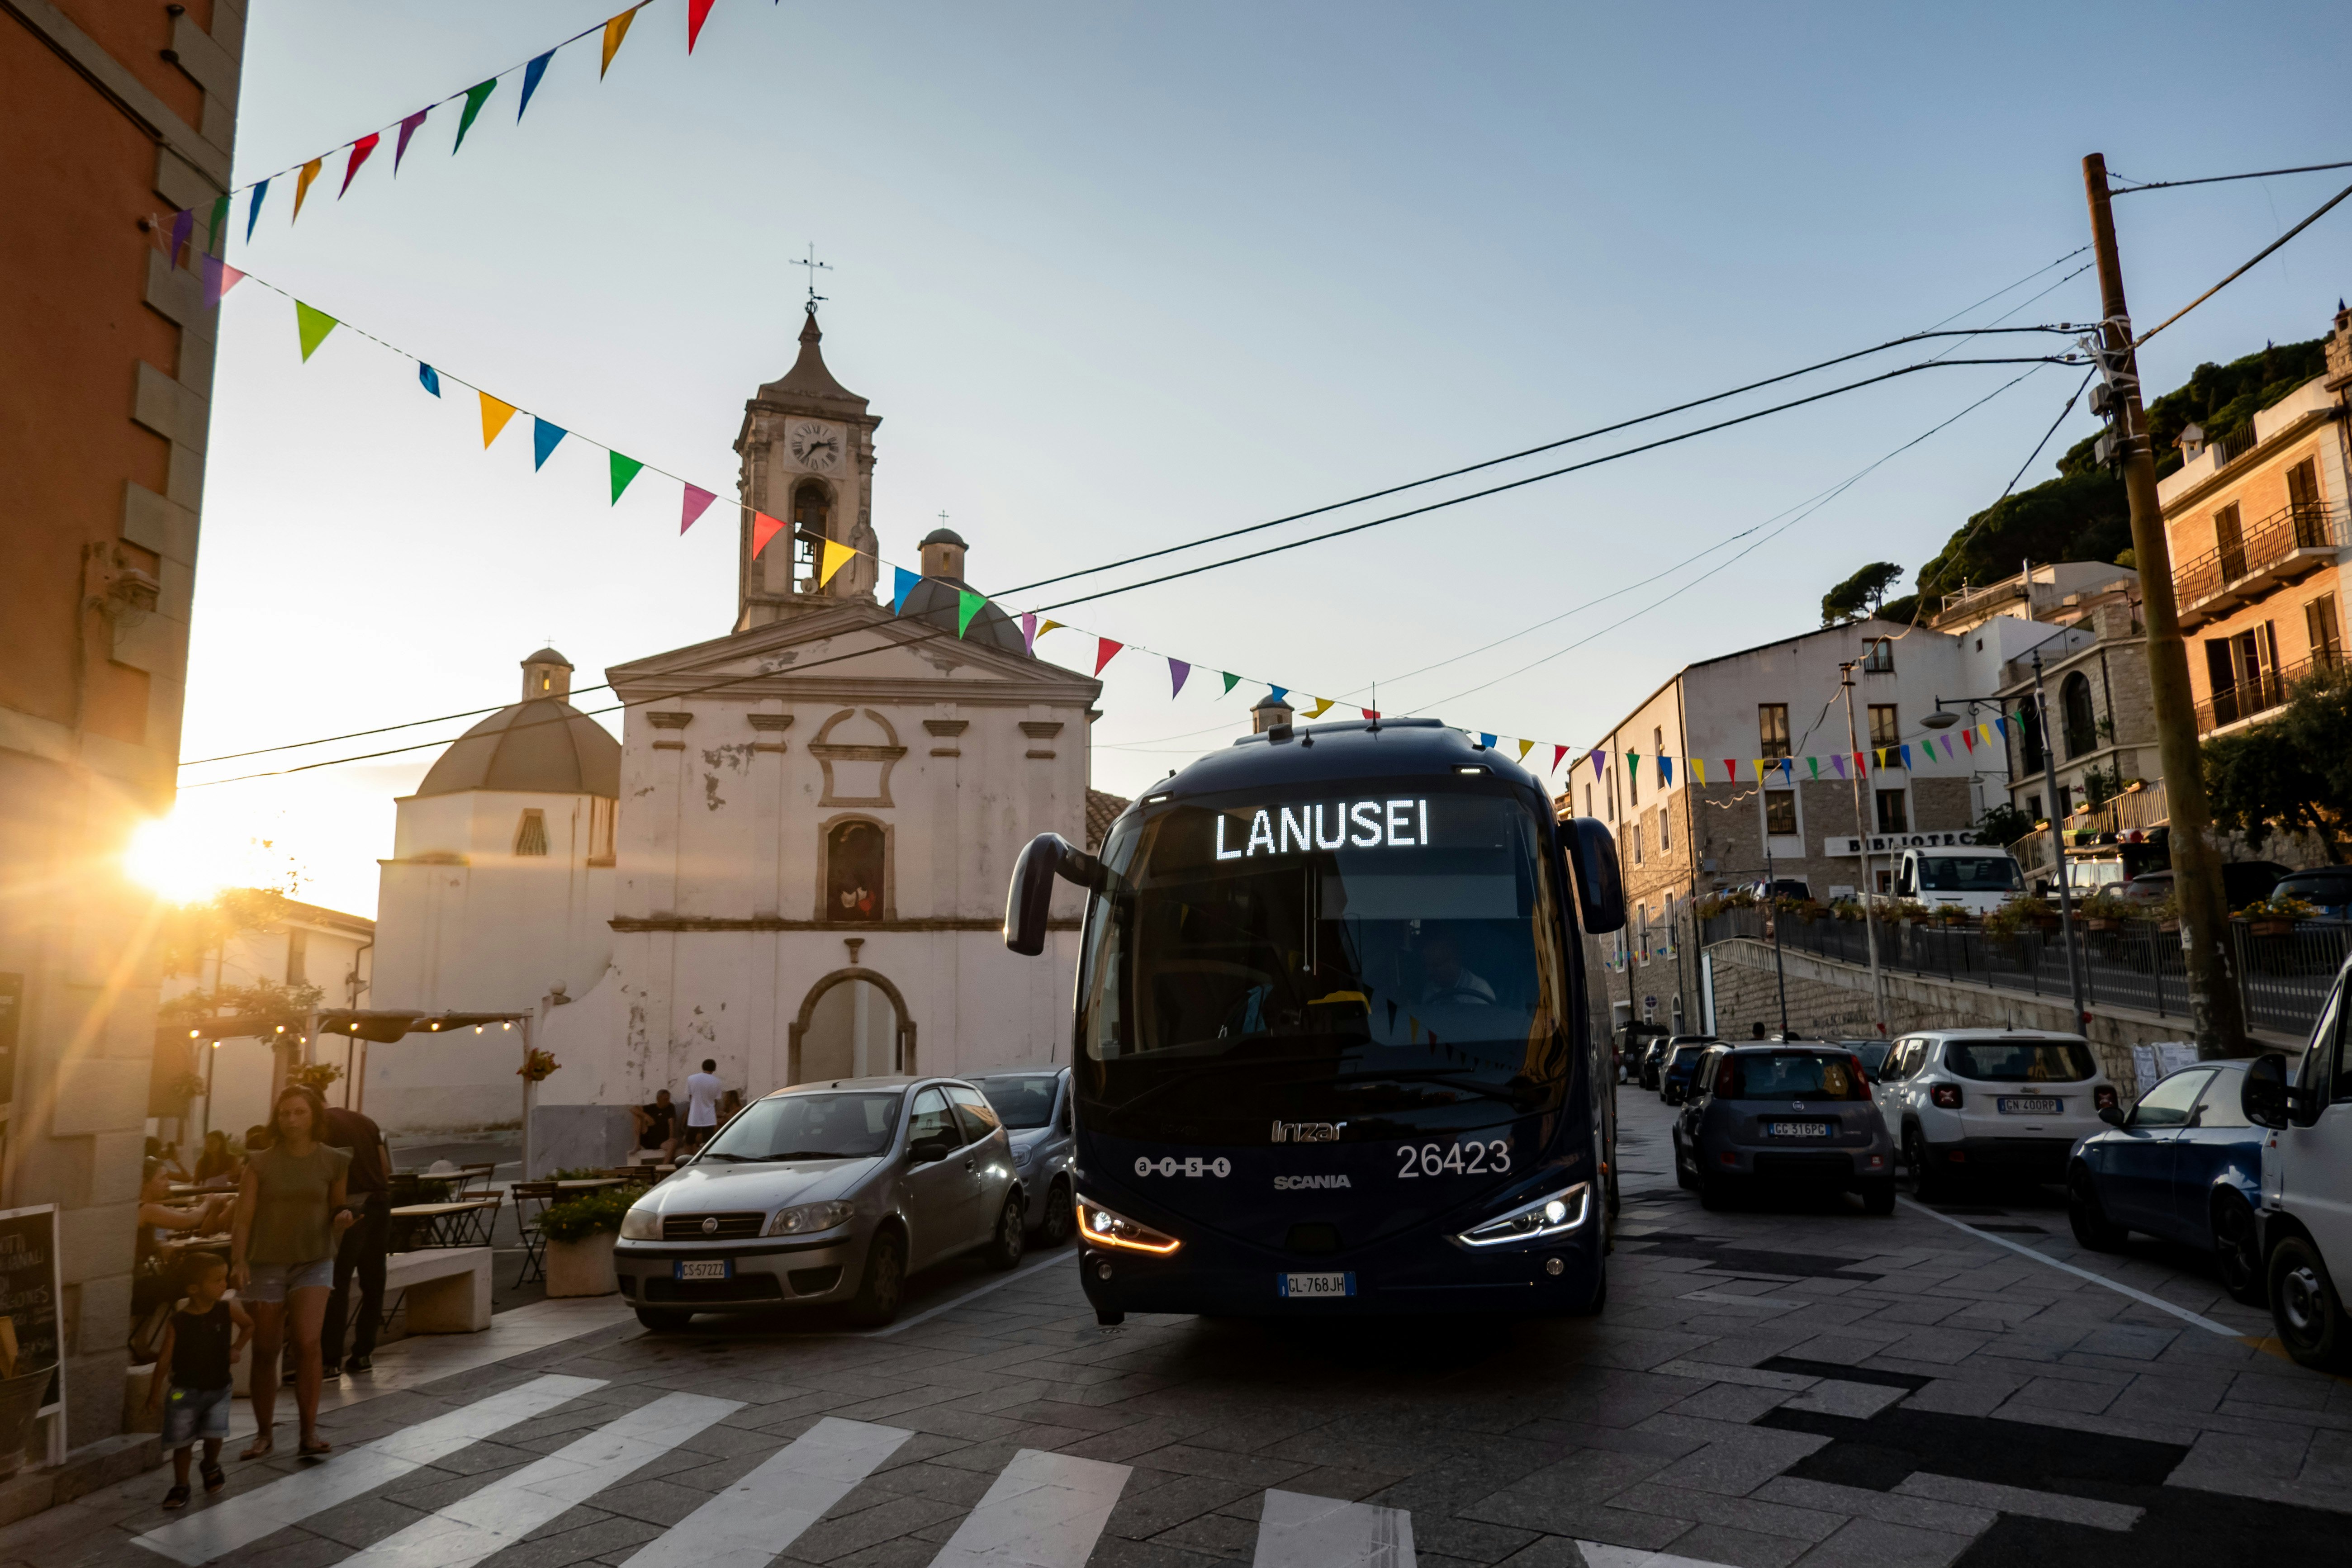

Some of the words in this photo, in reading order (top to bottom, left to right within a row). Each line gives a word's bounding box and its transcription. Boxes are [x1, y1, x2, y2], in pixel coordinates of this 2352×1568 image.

[1216, 799, 1428, 860] LANUSEI
[1849, 832, 1973, 852] BBLIOTEC
[1271, 1120, 1347, 1142] Irizar
[1138, 1159, 1225, 1174] arst
[1396, 1139, 1511, 1178] 26423
[1274, 1175, 1351, 1190] SCANIA
[1288, 1278, 1303, 1293] GL
[1307, 1277, 1344, 1292] 768JH
